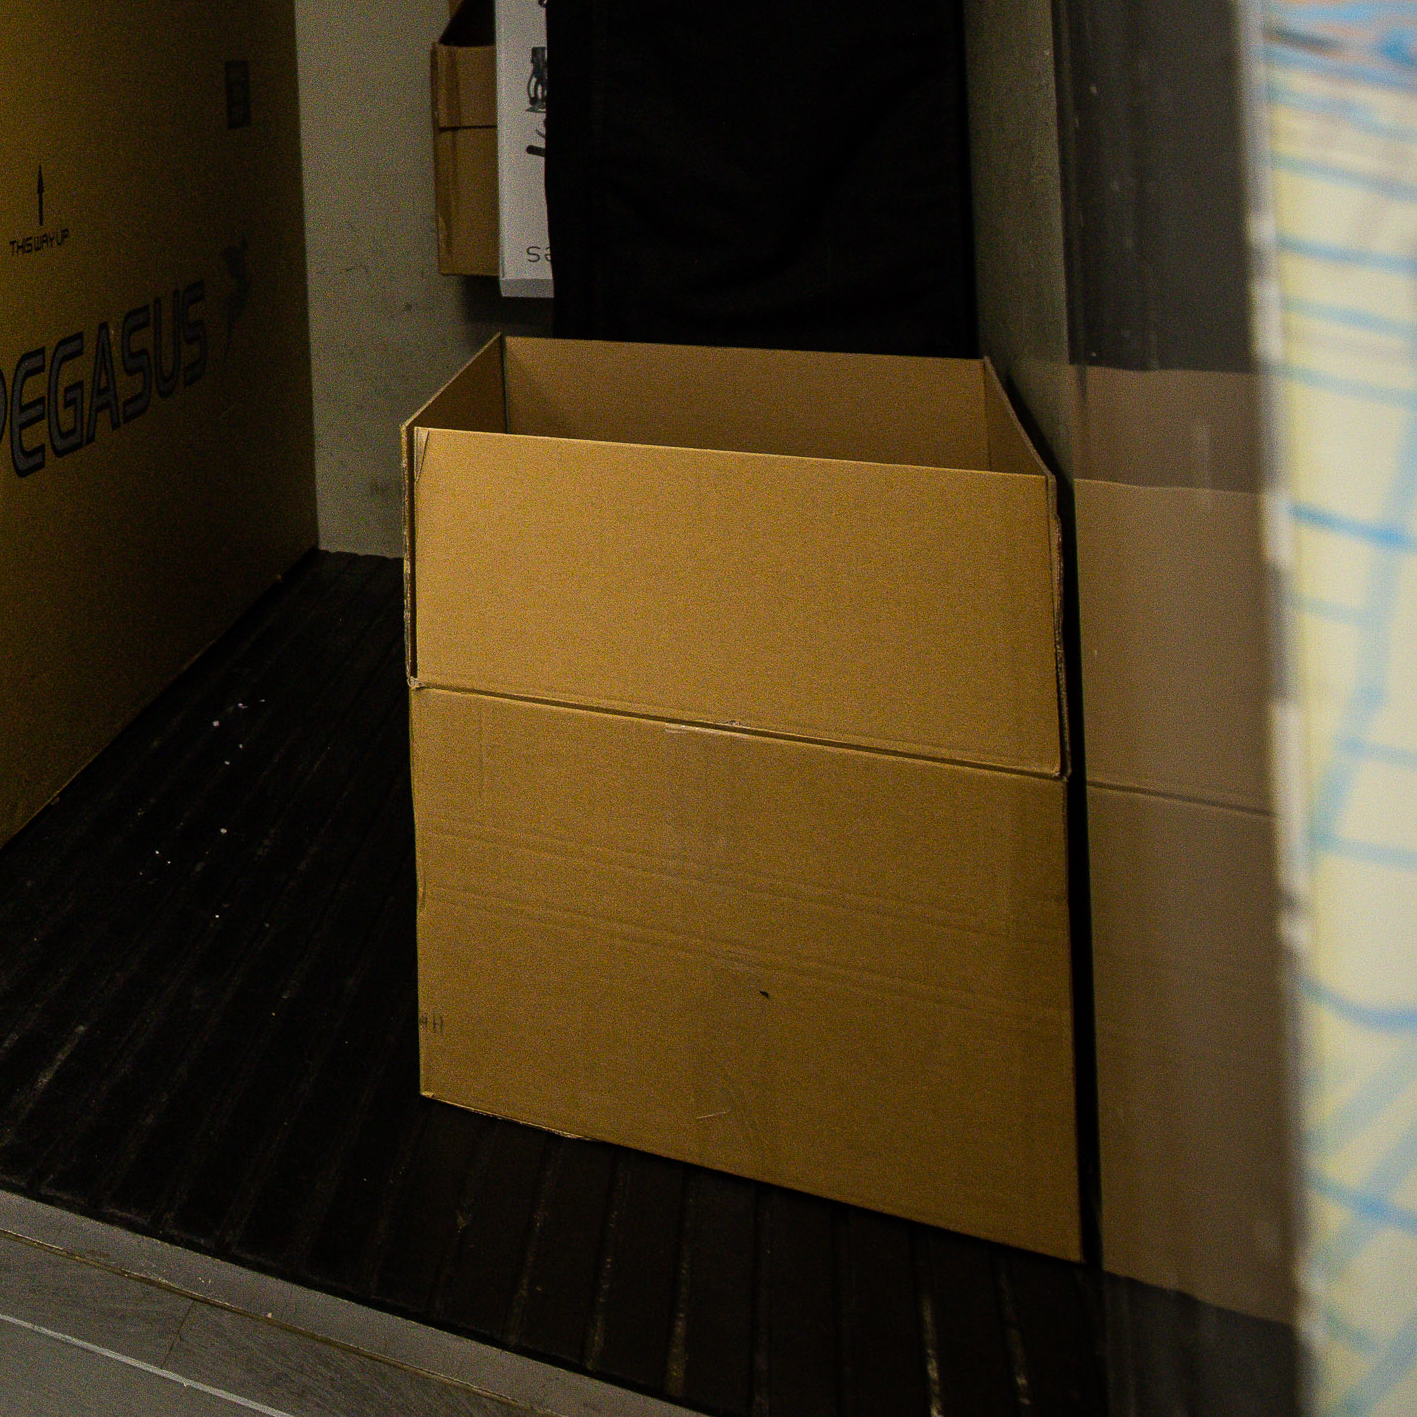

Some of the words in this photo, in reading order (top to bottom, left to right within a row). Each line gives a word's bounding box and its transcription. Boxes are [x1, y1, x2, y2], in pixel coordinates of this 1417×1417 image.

[9, 237, 33, 257] THIS
[33, 232, 56, 252] WAY
[56, 228, 70, 246] UP
